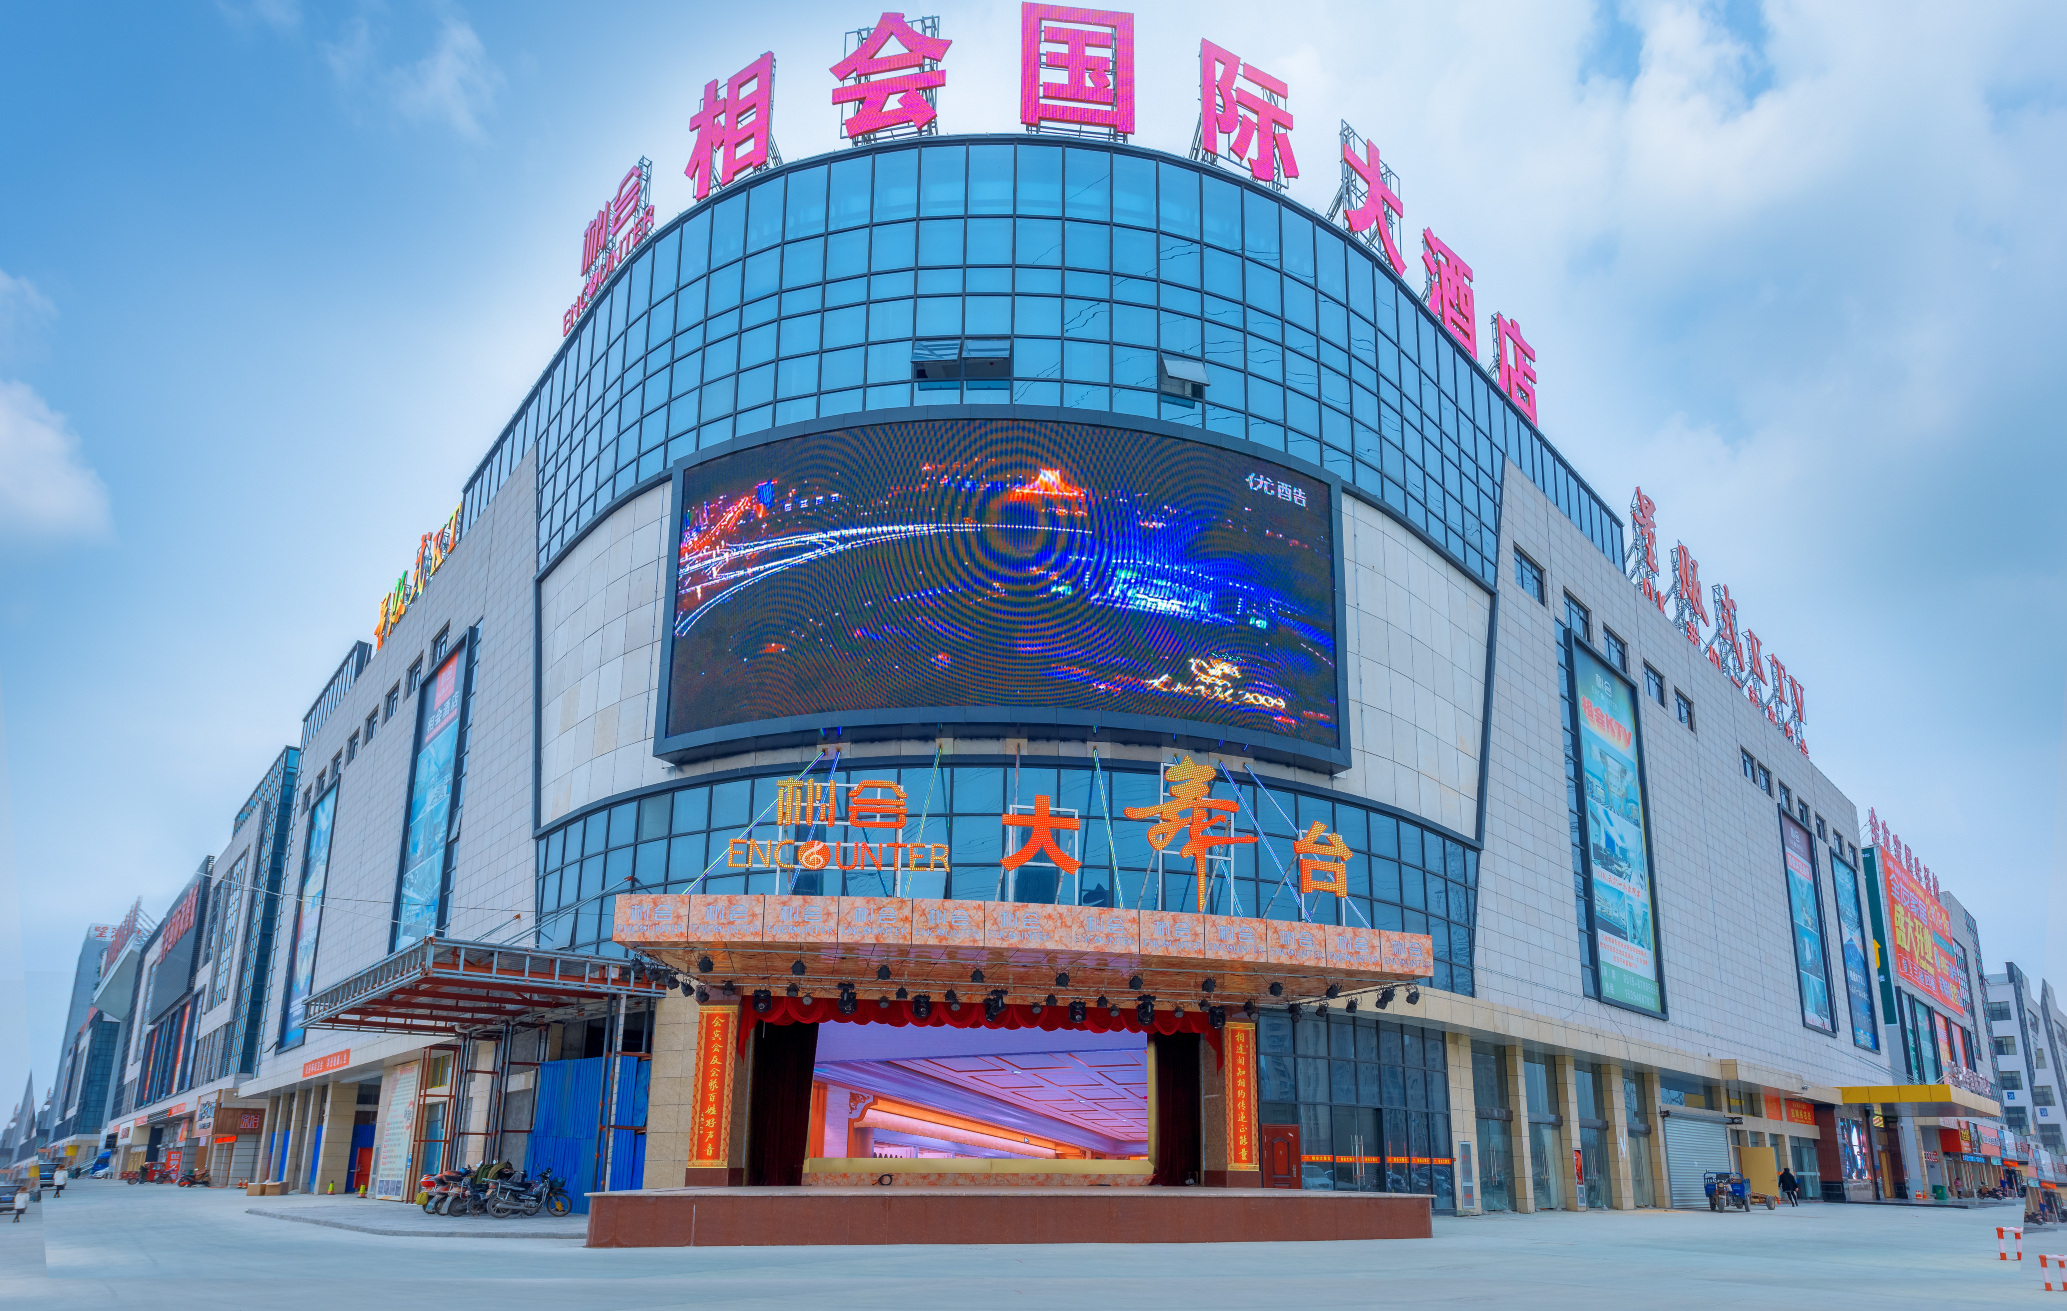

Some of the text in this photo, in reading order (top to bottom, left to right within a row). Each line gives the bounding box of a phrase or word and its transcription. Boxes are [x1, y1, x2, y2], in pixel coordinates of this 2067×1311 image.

[684, 2, 1538, 427] 相会国际大酒店
[563, 204, 655, 337] ENCOUNTER
[1246, 473, 1307, 507] 优酷
[426, 690, 460, 732] 相会酒店
[1580, 695, 1633, 750] 相会KTV
[777, 778, 908, 829] 相会
[999, 755, 1353, 912] 大舞台
[728, 839, 951, 873] ENCOUNTER
[1888, 873, 1929, 926] 全友家居
[617, 924, 683, 933] ENCOUNTER
[692, 924, 759, 933] ENCOUNTER
[767, 925, 834, 934] ENCOUNTER
[842, 926, 908, 936] ENCOUNTER
[915, 928, 980, 938] ENCOUNTER
[988, 930, 1052, 941] ENCOUNTER
[1074, 934, 1136, 946] ENCOUNTER
[1893, 903, 1935, 965] 盛大开业
[1143, 938, 1202, 950] ENCOUNTER
[1208, 942, 1264, 954] ENCOUNTER
[1270, 947, 1324, 959] ENCOUNTER
[1329, 951, 1379, 964] ENCOUNTER
[1383, 957, 1433, 968] ENCOUNTER
[703, 1015, 725, 1158] 会宾会友会聚百姓好声音
[1235, 1031, 1249, 1161] 相逢相知相约传递正能量
